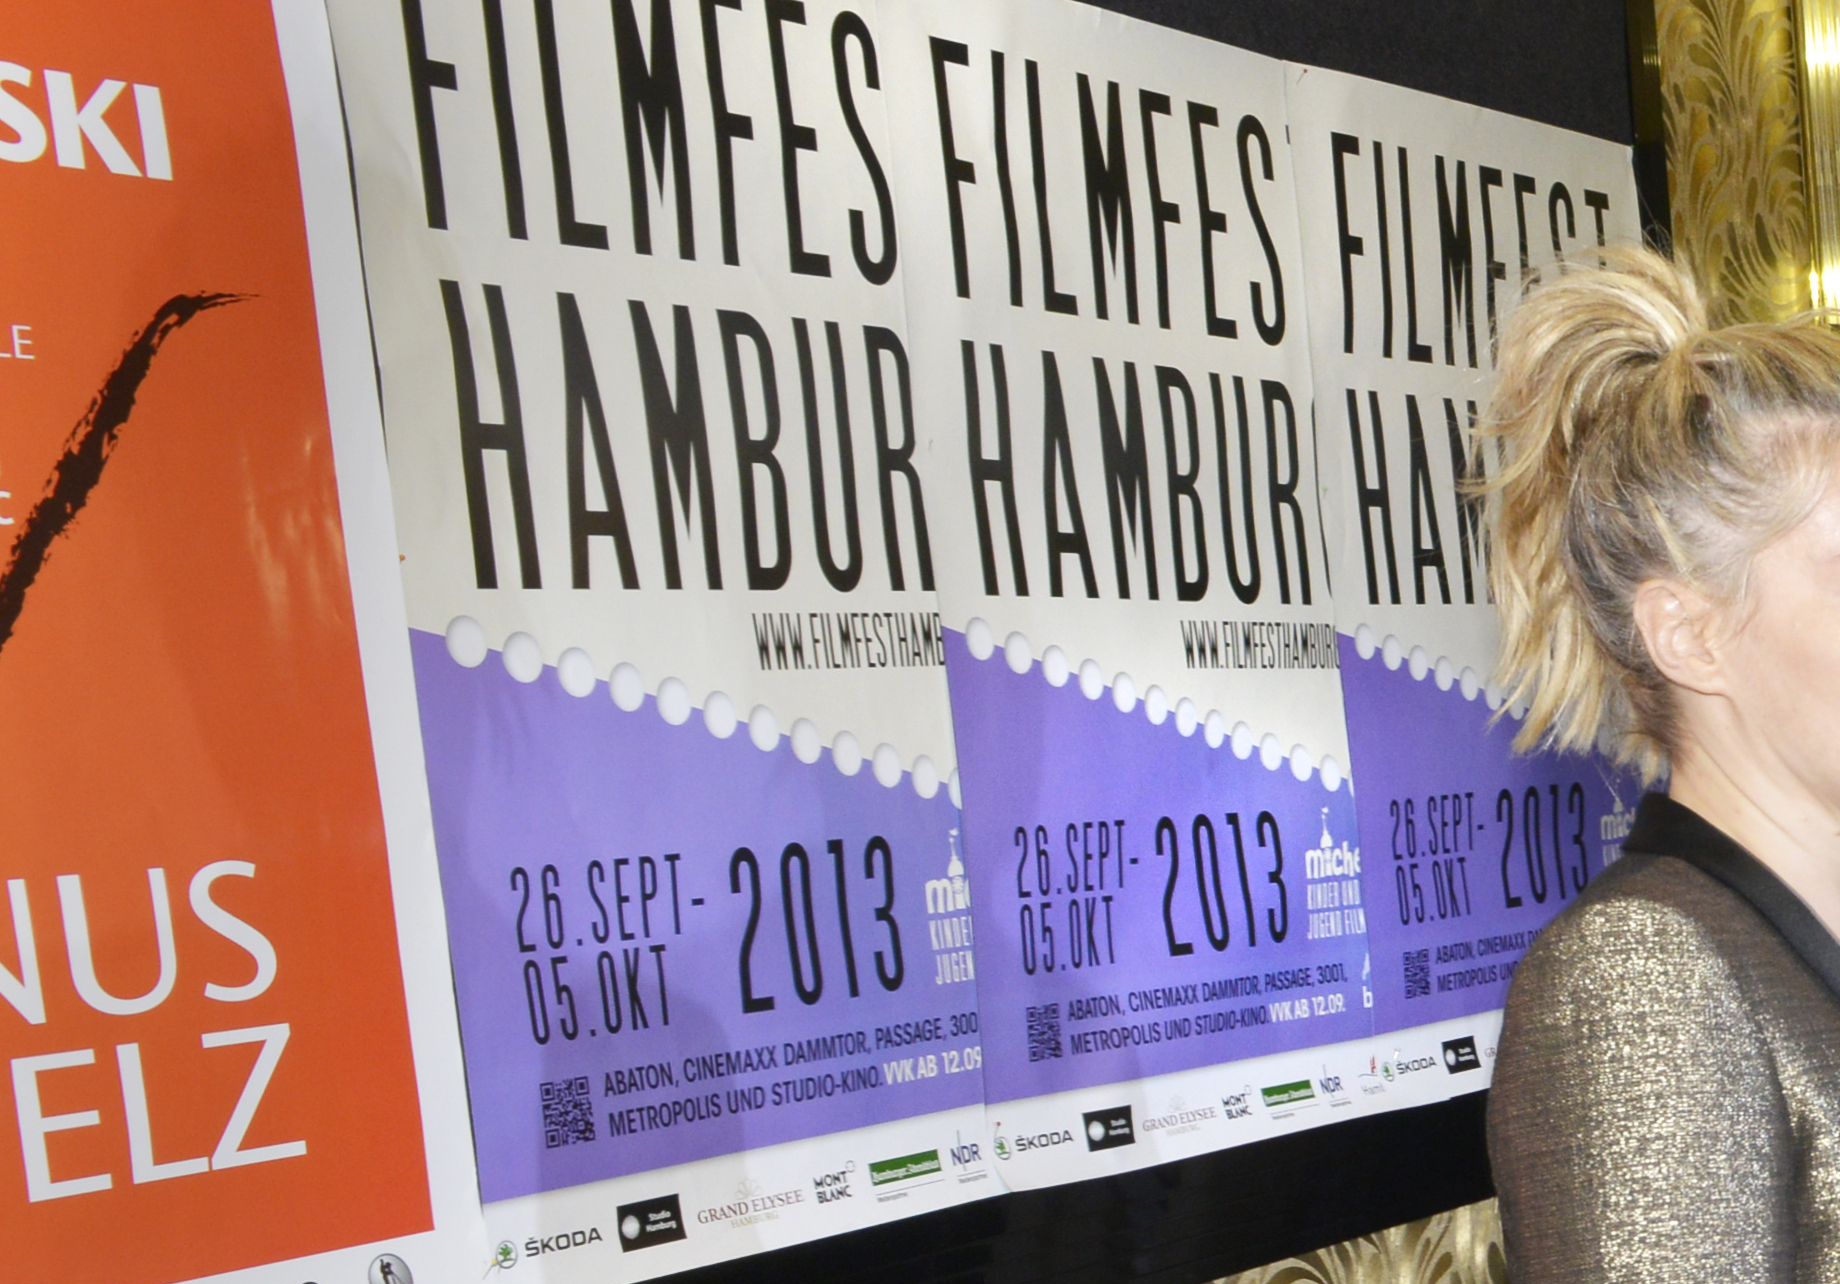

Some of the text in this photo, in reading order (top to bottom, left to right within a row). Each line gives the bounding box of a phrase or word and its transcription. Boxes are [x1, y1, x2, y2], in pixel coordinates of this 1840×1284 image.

[1496, 782, 1590, 911] 2013
[1154, 810, 1290, 958] 2013
[1395, 855, 1472, 927] 05.OKT
[729, 835, 905, 1015] 2013
[1021, 896, 1117, 976] 05.OKT
[523, 944, 672, 1046] 05.OKT
[1067, 993, 1126, 1022] ABATON,
[1128, 984, 1199, 1013] CINEMAXX
[1202, 973, 1262, 1001] DAMMTOR,
[1264, 967, 1316, 993] PASSAGE,
[603, 1061, 681, 1098] ABATON,
[683, 1046, 779, 1083] CINEMAXX
[783, 1032, 874, 1067] DAMMTOR,
[875, 1018, 948, 1050] PASSAGE,
[1070, 1021, 1162, 1055] METROPOLIS
[1164, 1018, 1192, 1041] UND
[608, 1092, 722, 1138] METROPOLIS
[728, 1088, 768, 1114] UND
[914, 1053, 938, 1078] AB
[1142, 1114, 1180, 1132] GRAND
[950, 1143, 983, 1167] NDR
[1015, 1129, 1075, 1152] ŠKODA
[697, 1189, 804, 1225] GRAND ELYSEE
[813, 1170, 848, 1190] MONT
[816, 1185, 853, 1204] BLANC
[524, 1225, 604, 1259] ŠKODA
